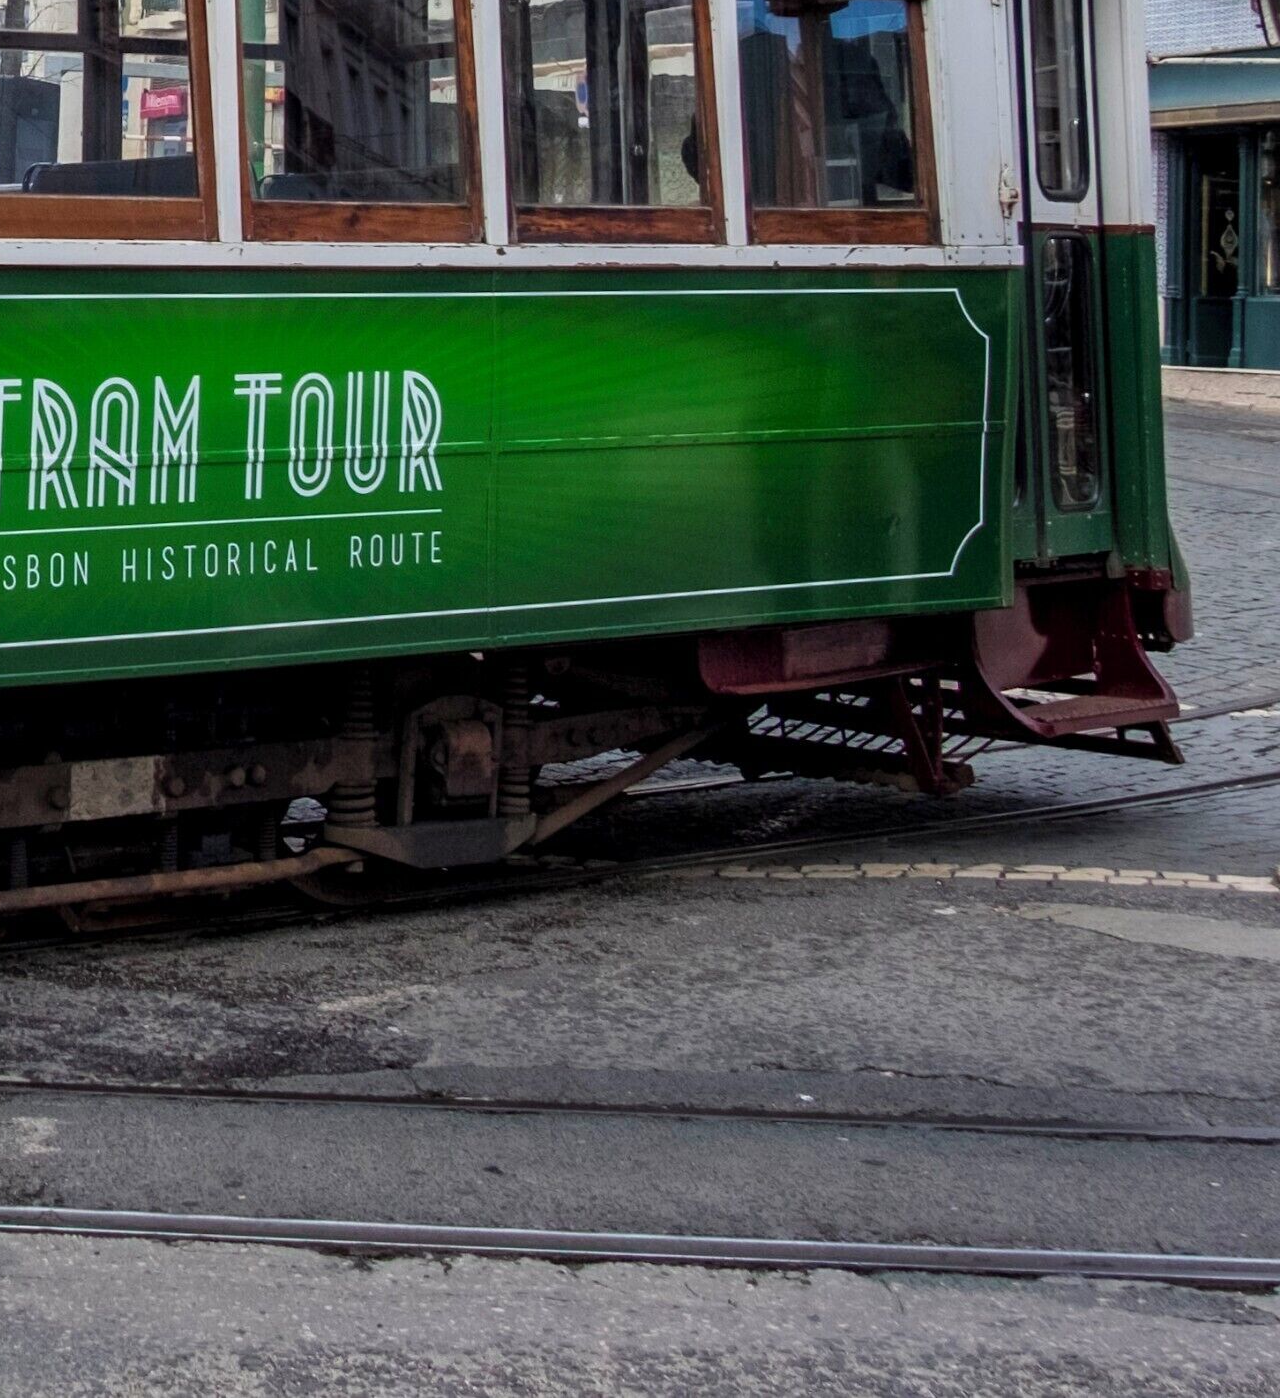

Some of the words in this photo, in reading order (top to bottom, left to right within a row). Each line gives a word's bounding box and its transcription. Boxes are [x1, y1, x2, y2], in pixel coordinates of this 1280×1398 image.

[234, 370, 443, 498] TOUR
[122, 538, 318, 583] HISTORICAL
[350, 531, 443, 568] ROUTE
